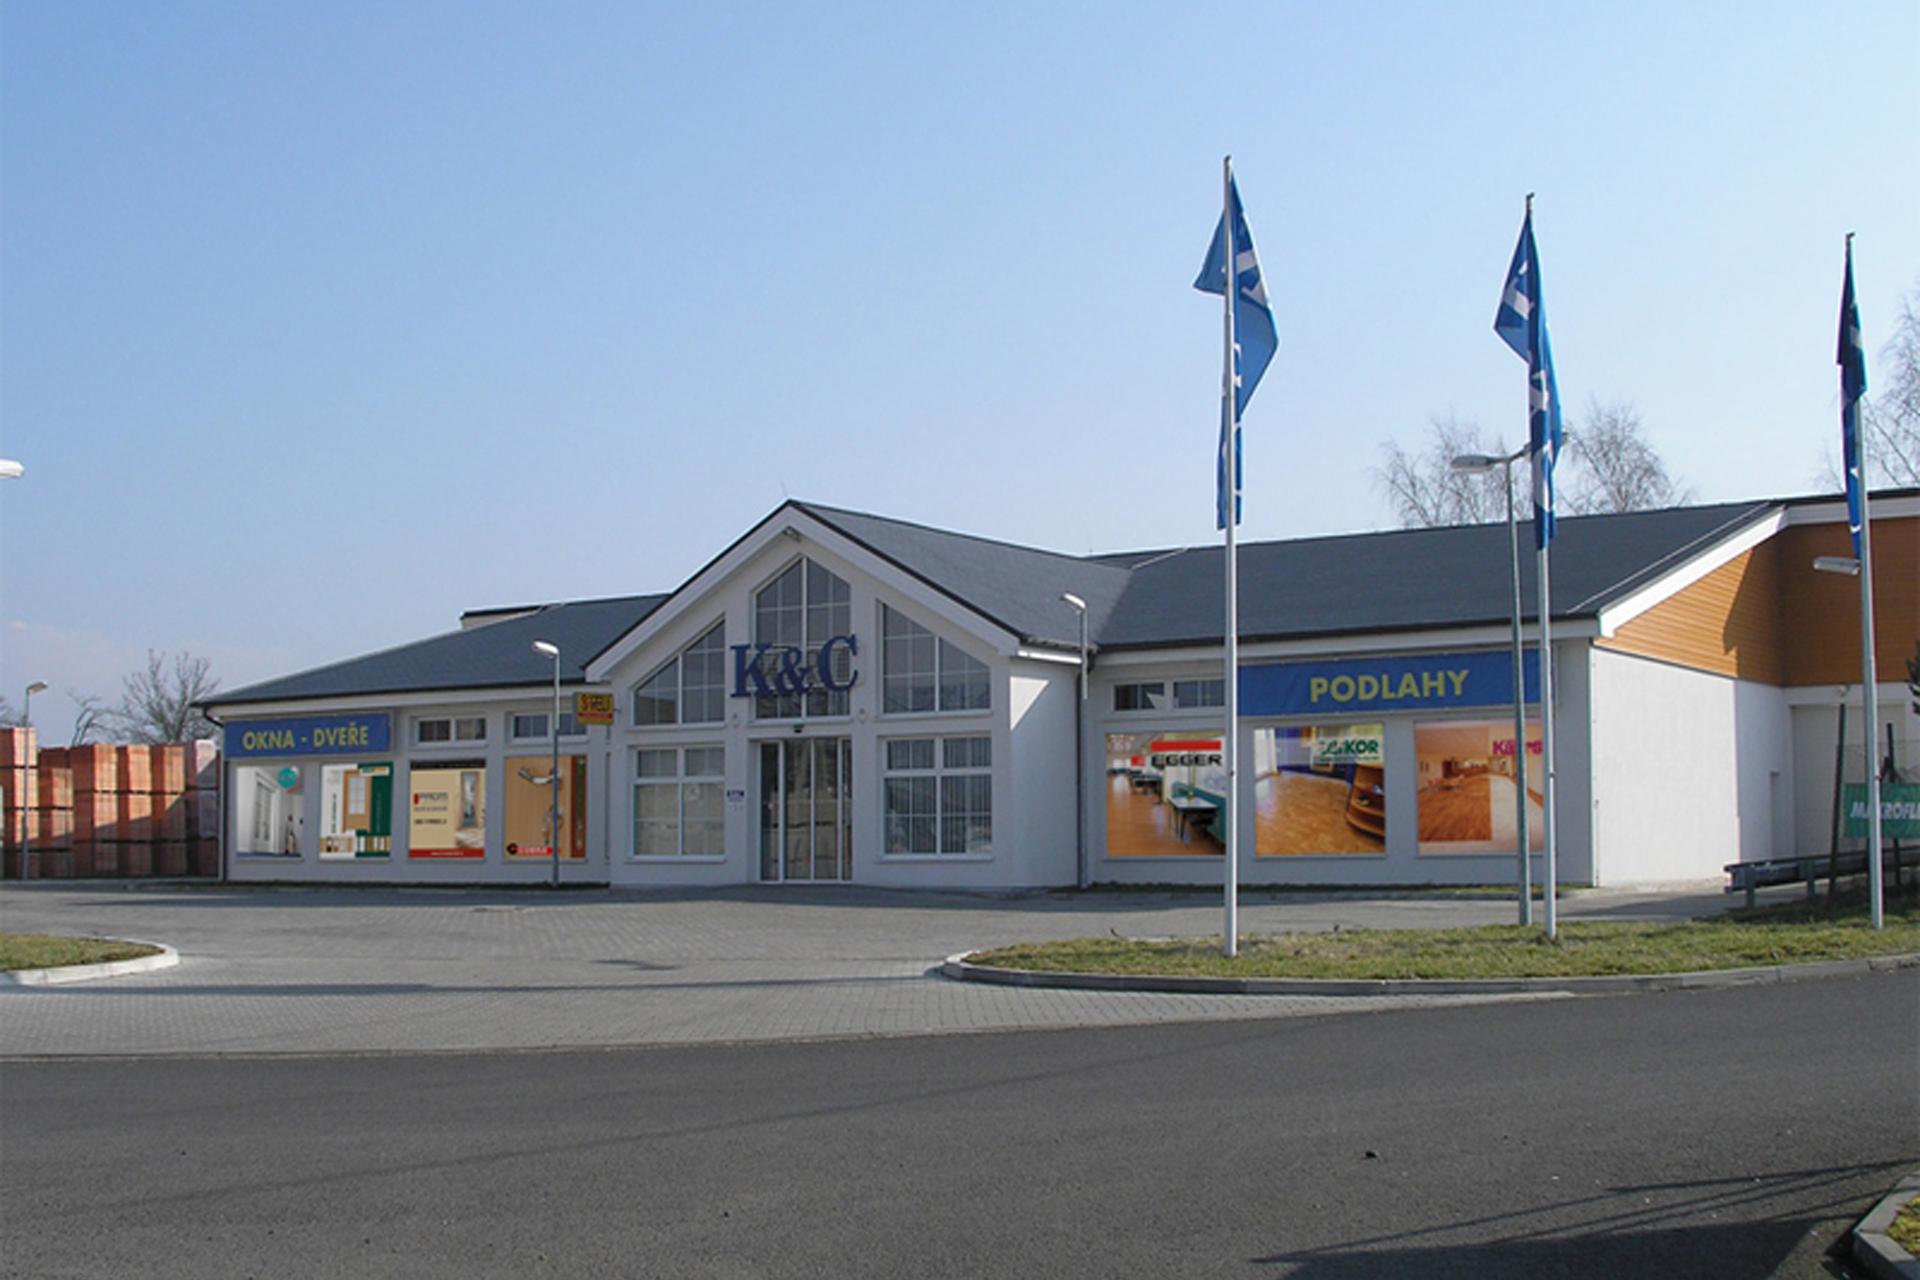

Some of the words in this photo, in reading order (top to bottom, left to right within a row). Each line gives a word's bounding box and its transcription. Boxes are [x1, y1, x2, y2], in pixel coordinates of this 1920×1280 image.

[730, 634, 858, 698] K&C
[1310, 669, 1469, 703] PODLAHY
[242, 729, 295, 750] OKNA
[313, 722, 369, 747] DVEŘE
[1151, 754, 1222, 770] EGGER
[1850, 801, 1920, 819] MROFL
